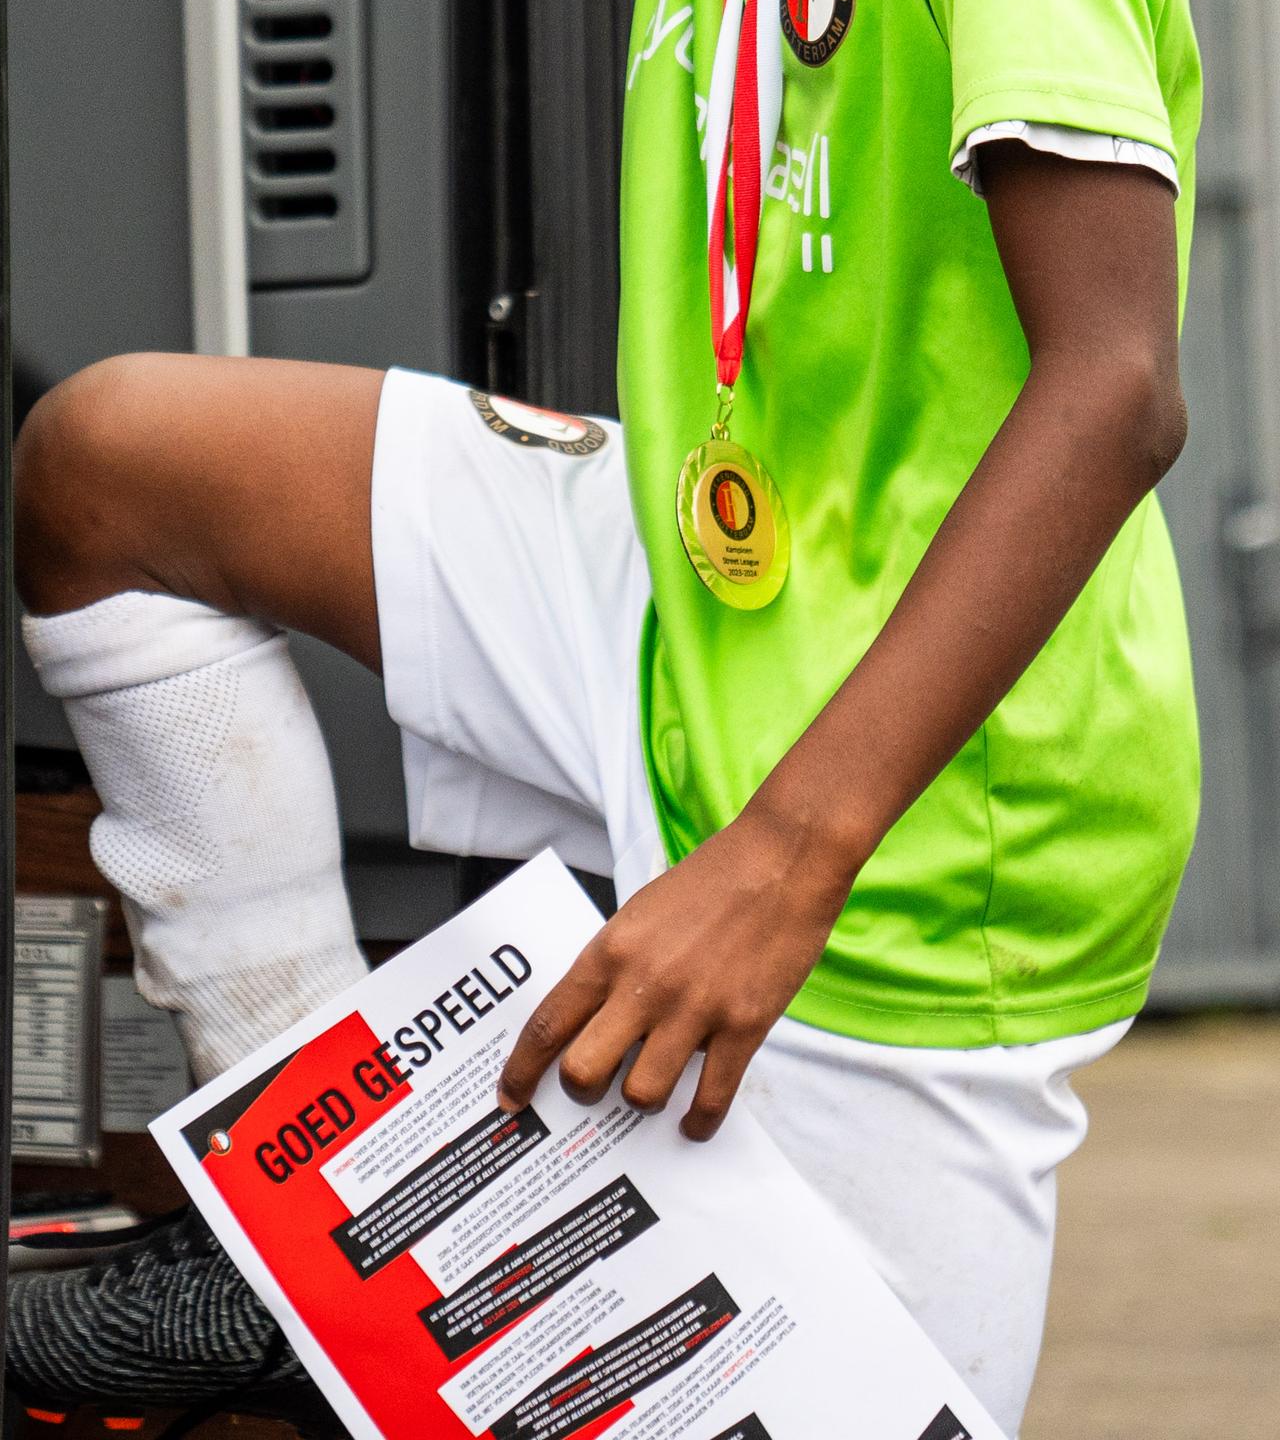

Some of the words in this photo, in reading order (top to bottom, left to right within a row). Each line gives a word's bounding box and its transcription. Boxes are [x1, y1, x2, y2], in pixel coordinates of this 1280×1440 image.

[780, 2, 845, 62] ROTTERDAM
[725, 545, 753, 555] Kampioen
[255, 1085, 356, 1185] GOED
[352, 943, 533, 1096] GESPEELD
